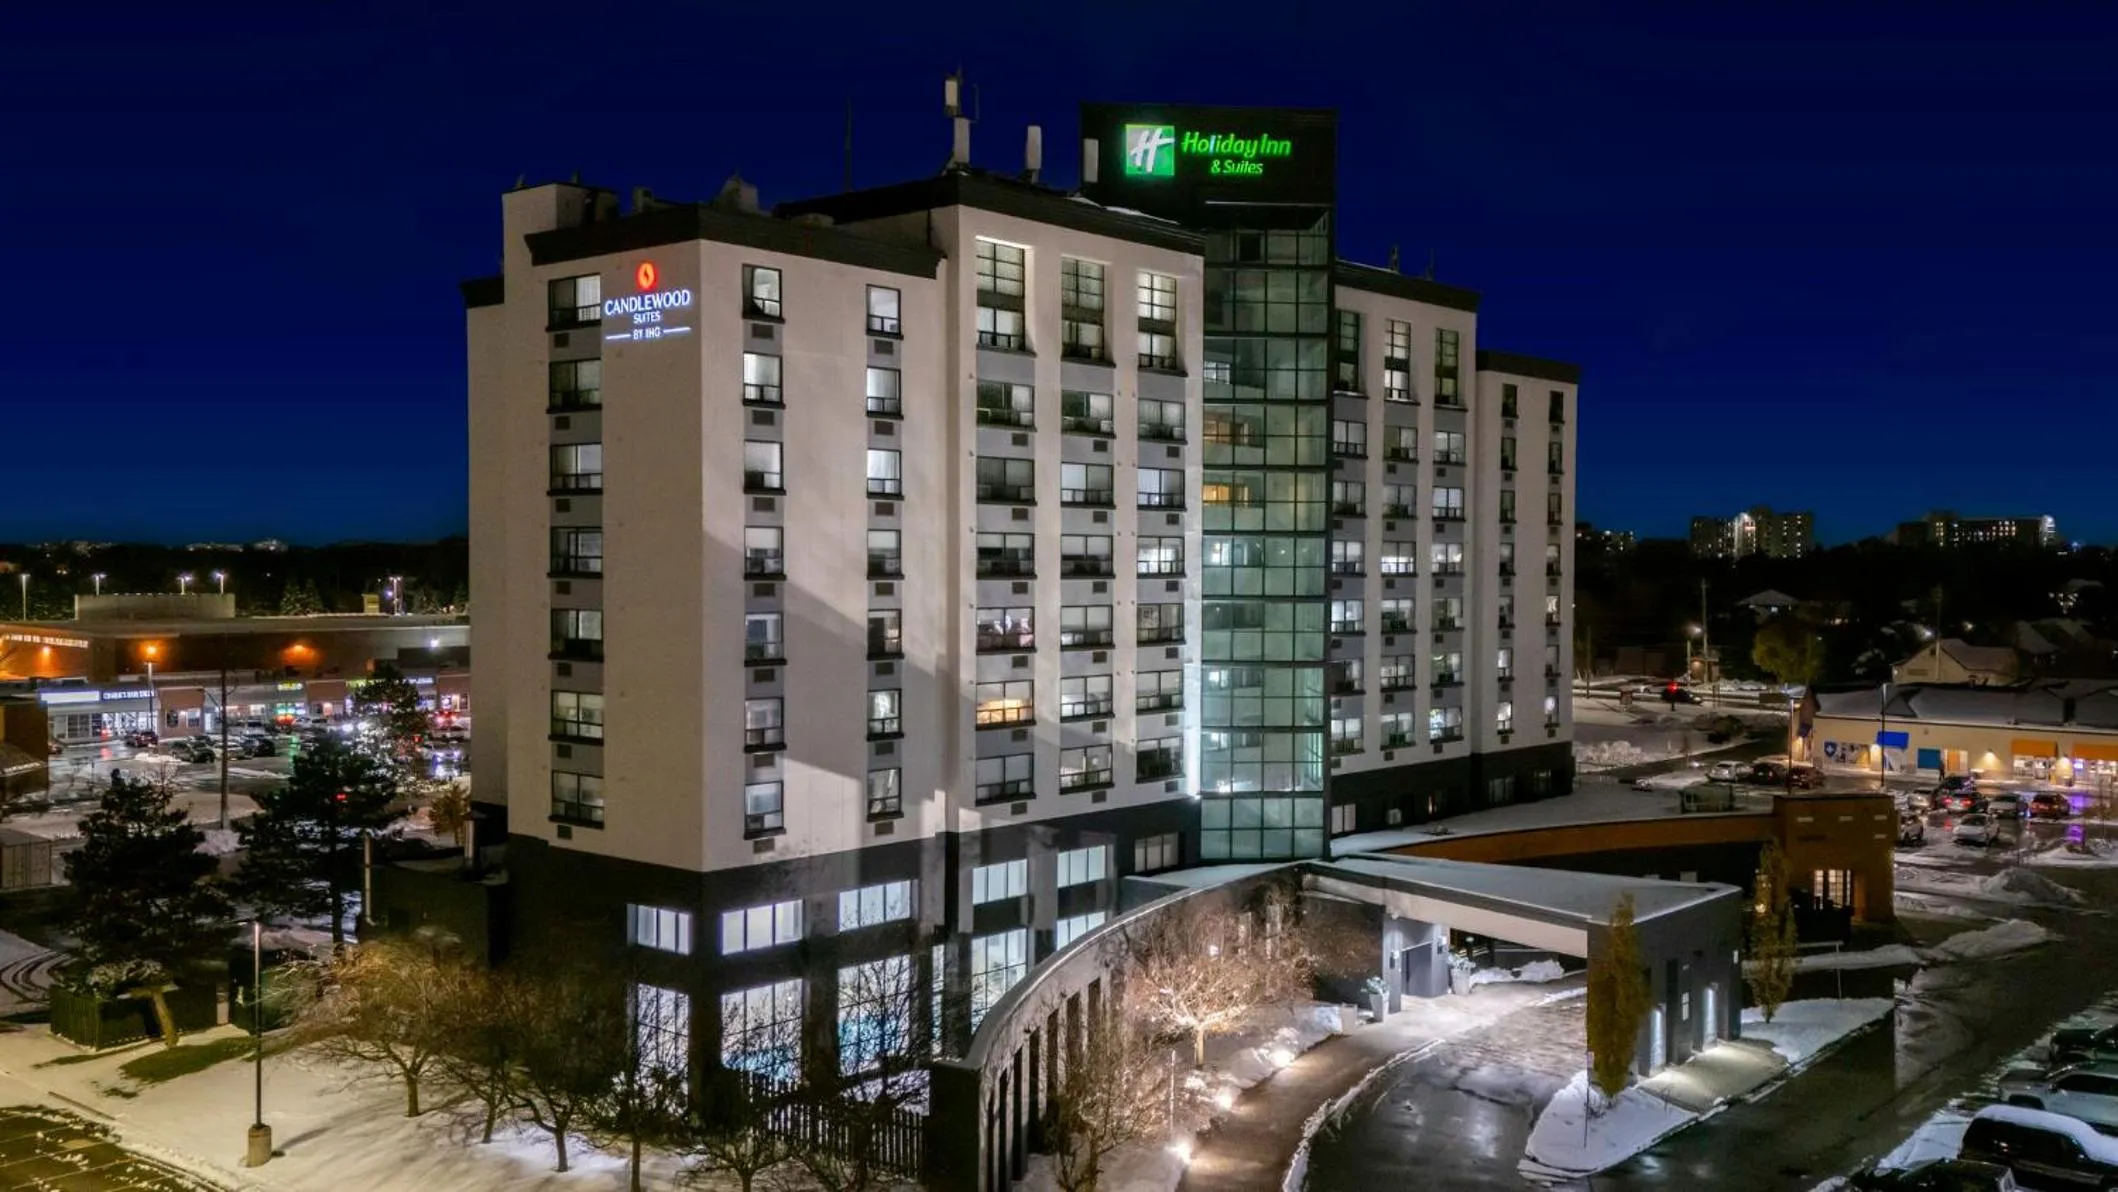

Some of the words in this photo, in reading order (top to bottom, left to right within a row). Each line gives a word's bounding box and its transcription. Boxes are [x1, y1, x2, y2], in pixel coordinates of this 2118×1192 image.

[1181, 131, 1258, 158] Holiday
[1261, 133, 1292, 154] Inn
[1210, 159, 1221, 174] &
[1223, 159, 1264, 174] Suites
[605, 289, 690, 315] CANDLEWOOD
[633, 311, 660, 324] SUITES
[633, 329, 643, 340] BY
[645, 327, 660, 338] IHG
